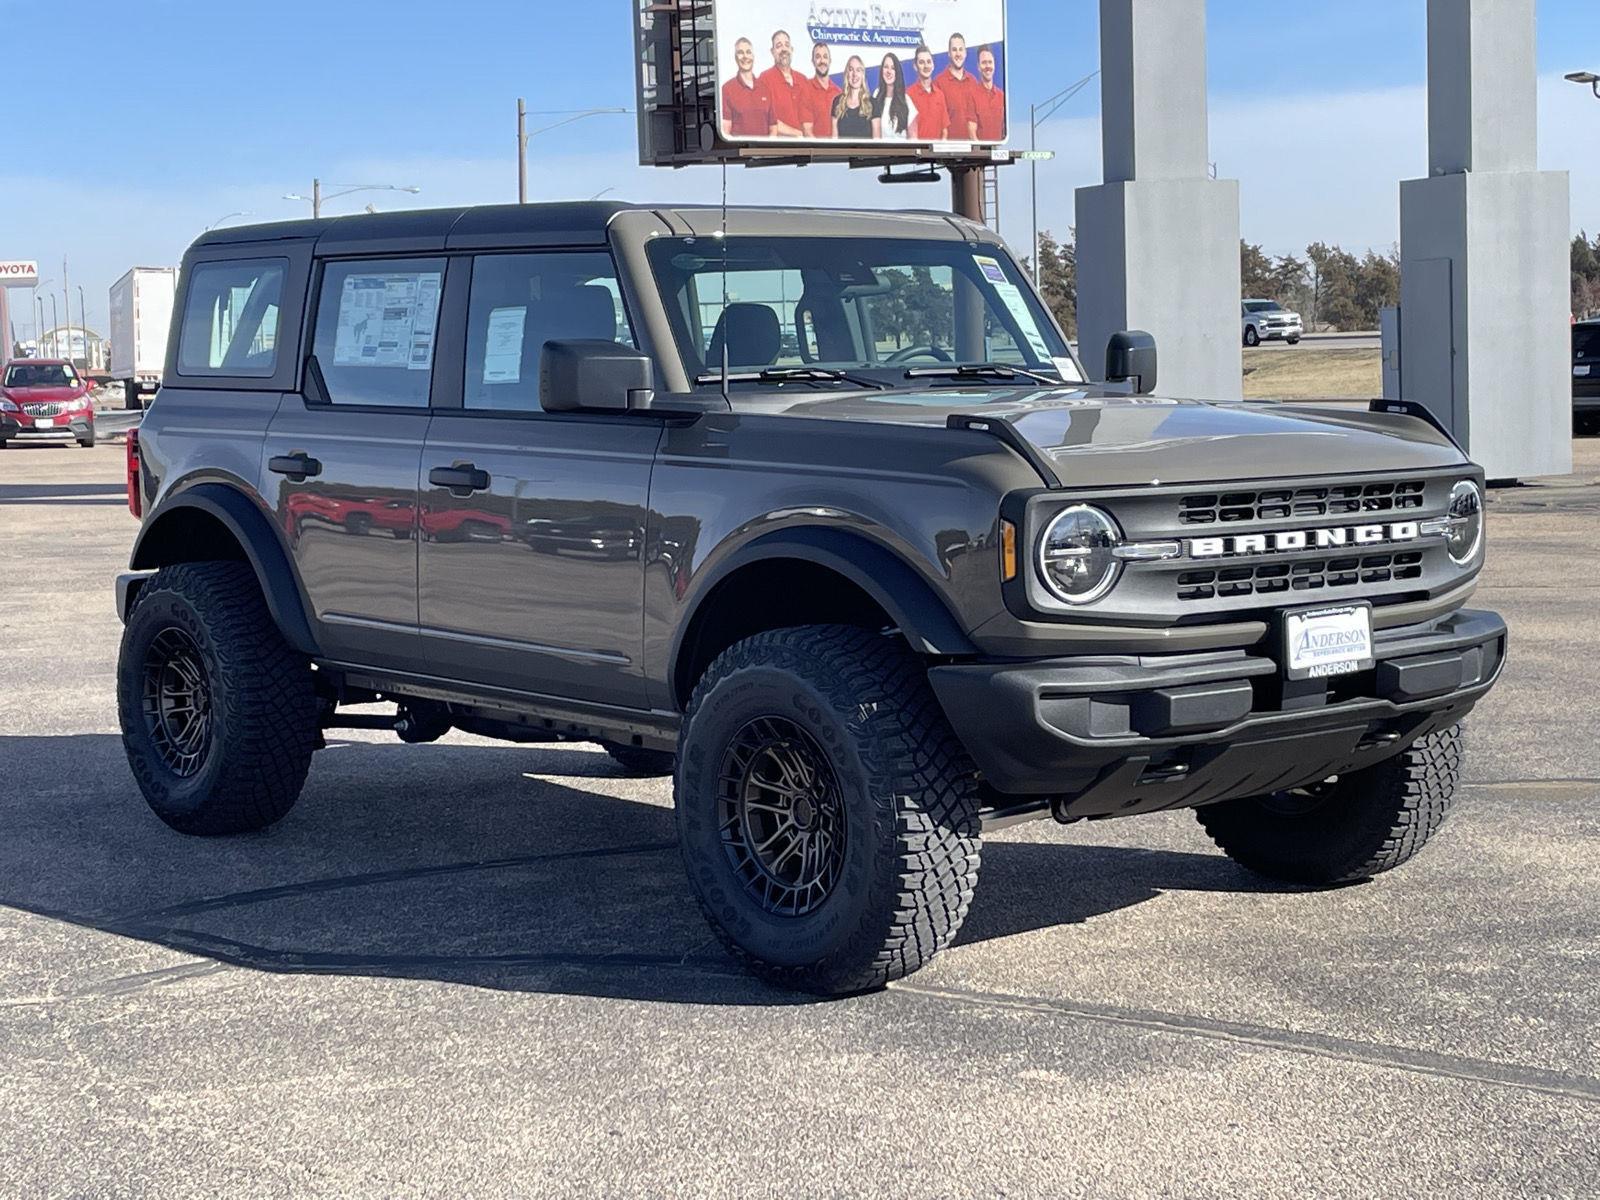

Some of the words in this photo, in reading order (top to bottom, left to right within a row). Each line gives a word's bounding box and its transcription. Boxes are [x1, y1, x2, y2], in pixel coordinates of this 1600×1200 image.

[811, 28, 860, 43] Chiropractic
[861, 31, 872, 42] &
[872, 32, 923, 45] Acupuncture
[0, 264, 36, 274] YOTA
[1190, 521, 1418, 557] BRONCO
[1294, 628, 1366, 661] ANDERSON
[1308, 660, 1358, 678] ANDERSON
